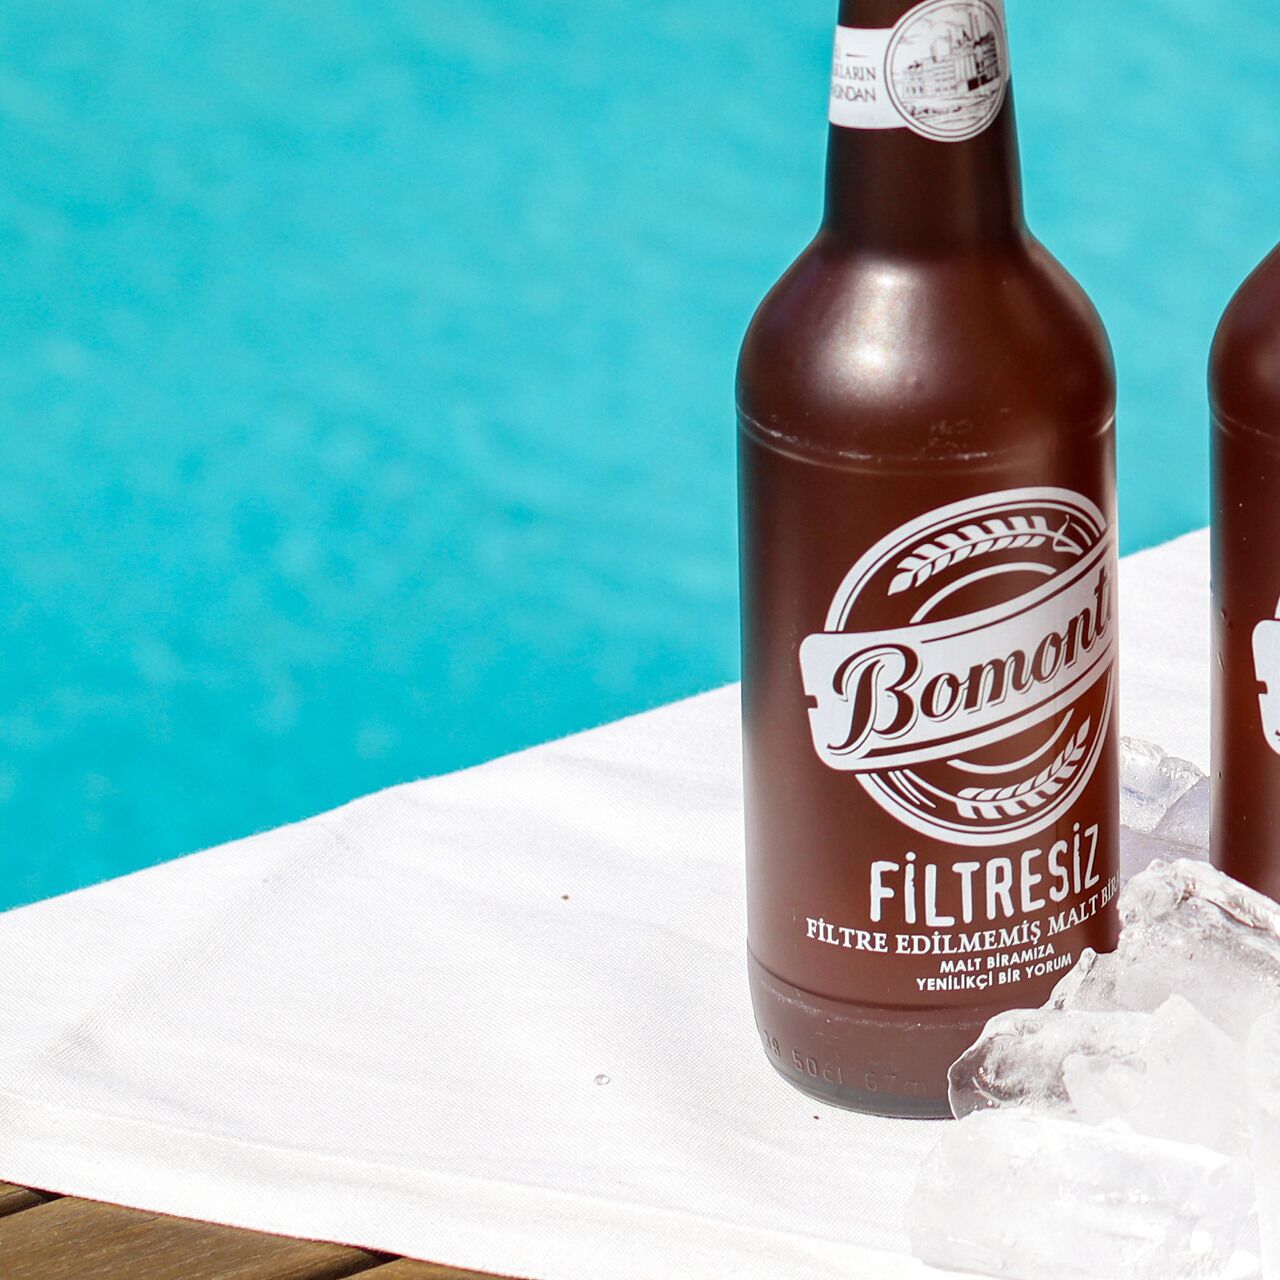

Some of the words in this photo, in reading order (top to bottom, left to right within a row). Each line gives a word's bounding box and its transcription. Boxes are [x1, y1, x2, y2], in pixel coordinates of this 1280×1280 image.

[869, 823, 1100, 927] FİLTRESİZ
[805, 916, 889, 953] FİLTRE
[895, 919, 1042, 956] EDİLMEMİŞ
[1047, 893, 1099, 937] MALT
[1100, 873, 1120, 908] BİR
[915, 976, 993, 992] YENİLİKÇİ
[998, 967, 1021, 985] BİR
[1025, 953, 1073, 979] YORUM
[939, 957, 982, 974] MALT
[986, 942, 1055, 968] BİRAMIZA
